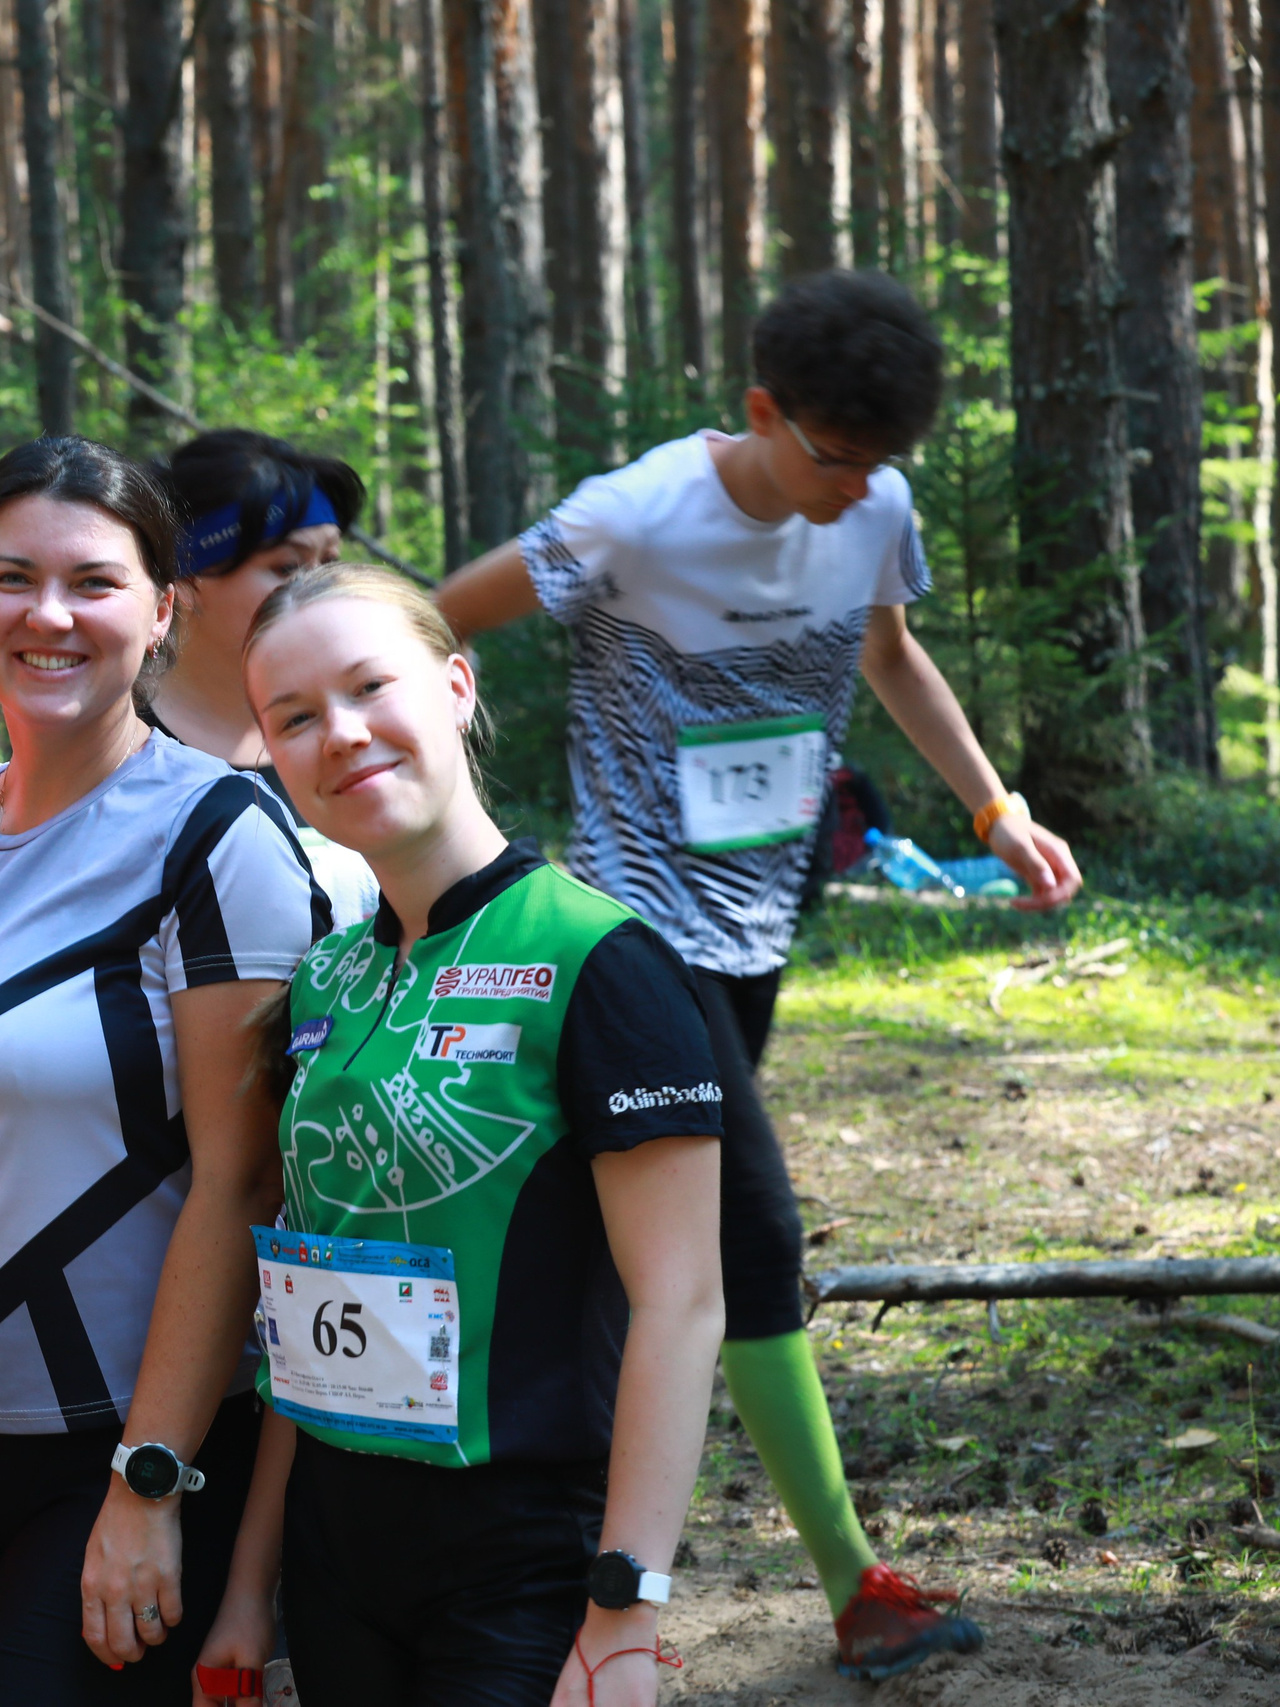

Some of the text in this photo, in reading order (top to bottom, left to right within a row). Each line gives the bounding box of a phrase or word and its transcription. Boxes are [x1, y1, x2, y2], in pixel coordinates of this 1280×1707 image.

[462, 967, 552, 987] УРАЛГЕО
[457, 986, 488, 996] ГРУППА
[455, 1049, 515, 1061] TECHNOPORT
[312, 1299, 367, 1358] 65
